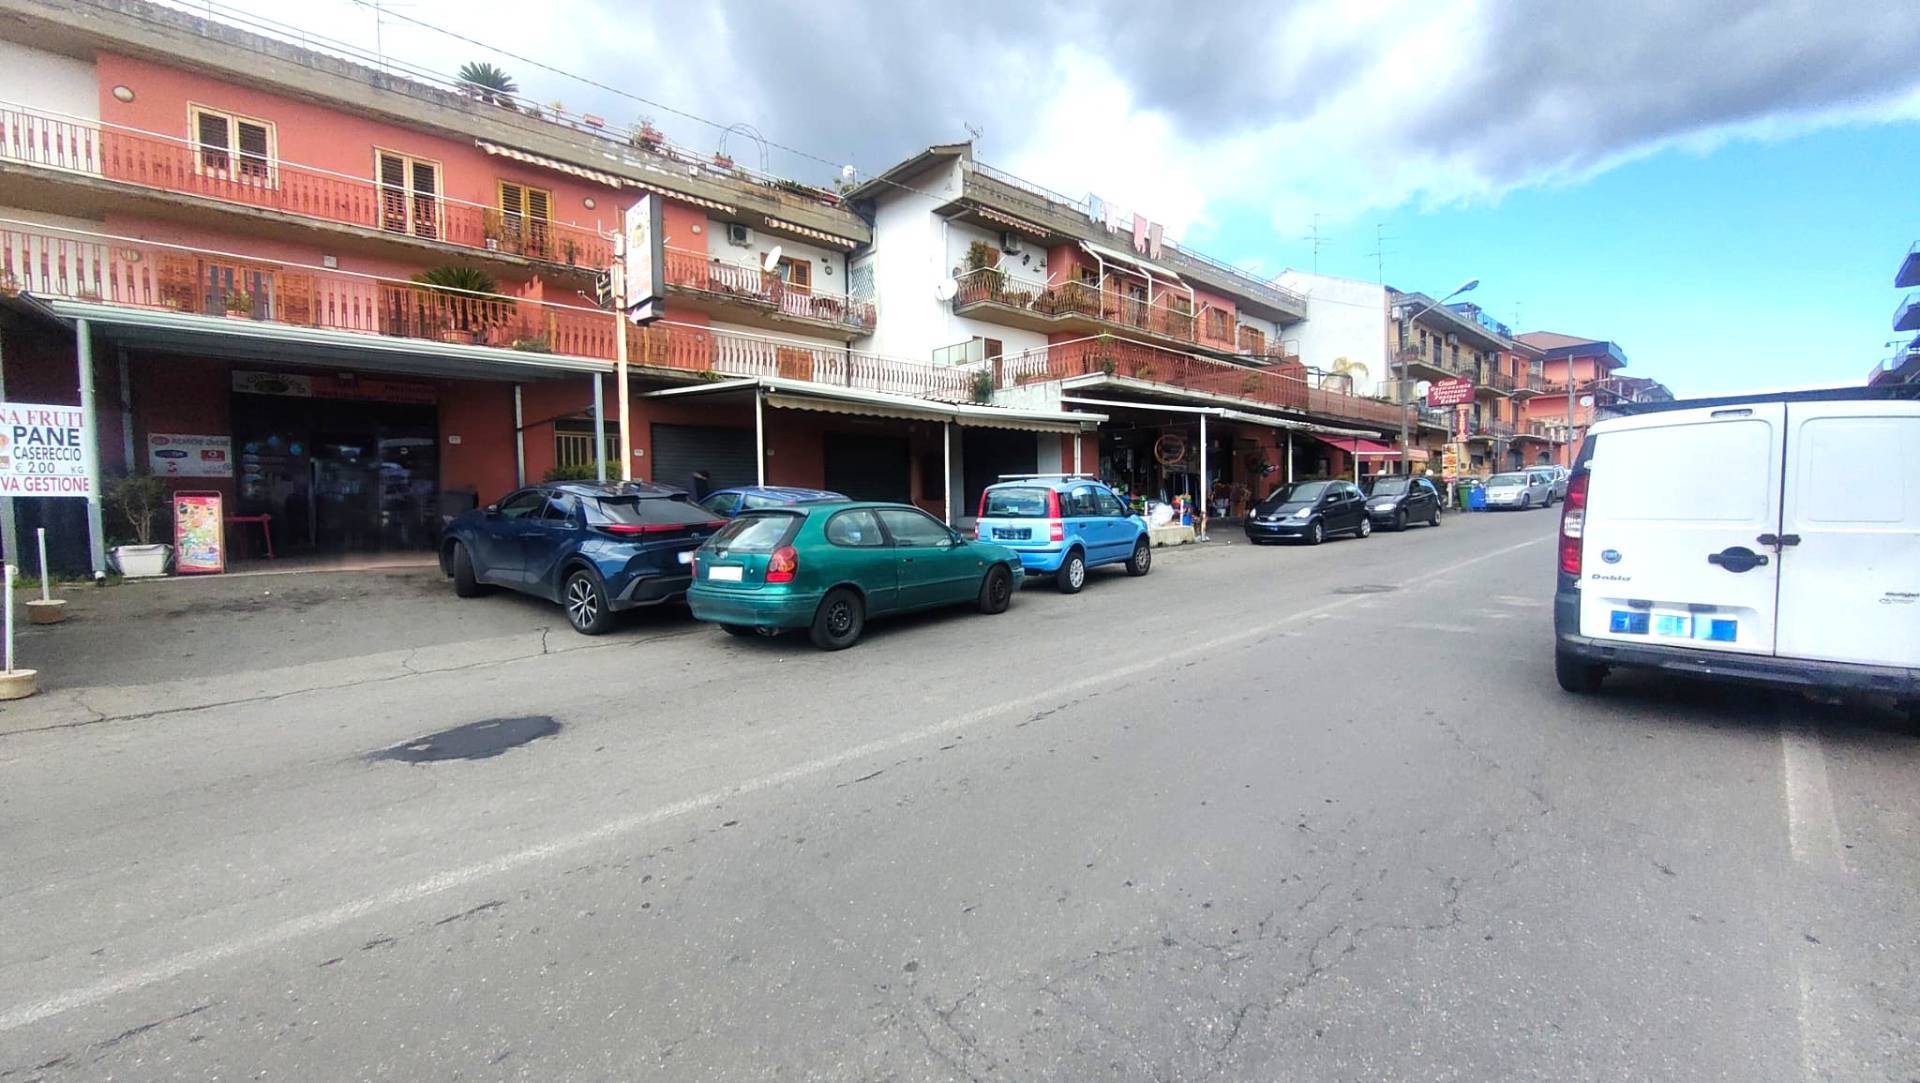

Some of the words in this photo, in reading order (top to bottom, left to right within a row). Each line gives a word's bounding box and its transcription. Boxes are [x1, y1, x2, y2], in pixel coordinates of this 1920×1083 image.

[13, 426, 80, 446] PANE
[13, 446, 82, 461] CASERECCIO
[71, 466, 84, 474] KG
[0, 476, 20, 491] VA
[23, 476, 89, 492] GESTIONE
